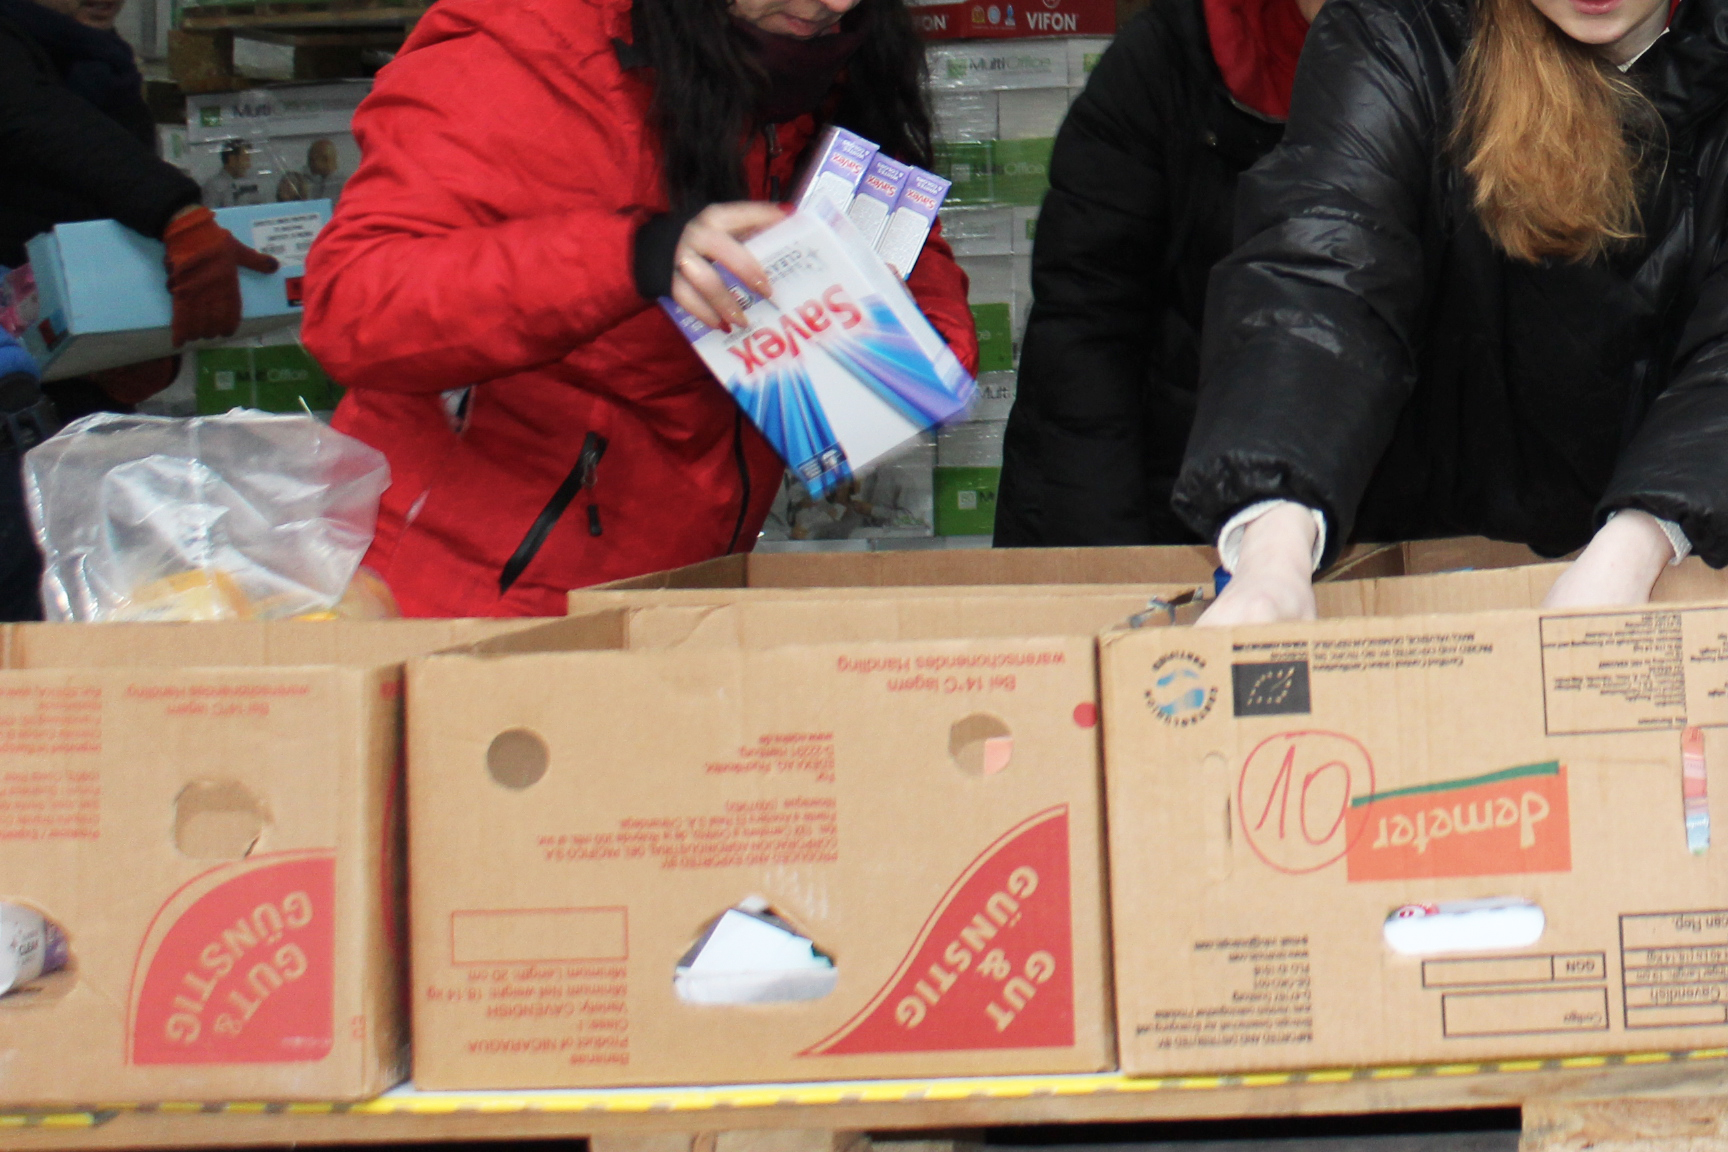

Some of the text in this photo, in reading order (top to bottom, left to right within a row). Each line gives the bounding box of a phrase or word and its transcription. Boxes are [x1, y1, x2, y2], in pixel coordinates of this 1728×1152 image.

[1026, 10, 1079, 31] VIFON
[728, 283, 862, 376] Savex
[836, 654, 911, 674] Handling
[887, 675, 940, 693] lagern
[1255, 744, 1351, 845] 10
[1372, 791, 1550, 848] demeter
[165, 890, 313, 1044] GÜNSTIG
[895, 865, 1039, 1029] GÜNSTIG
[975, 948, 1011, 980] &
[230, 944, 308, 1020] GUT
[487, 1003, 575, 1018] CAVENDISH
[984, 950, 1055, 1033] GUT
[468, 1038, 556, 1053] NICARAGUA
